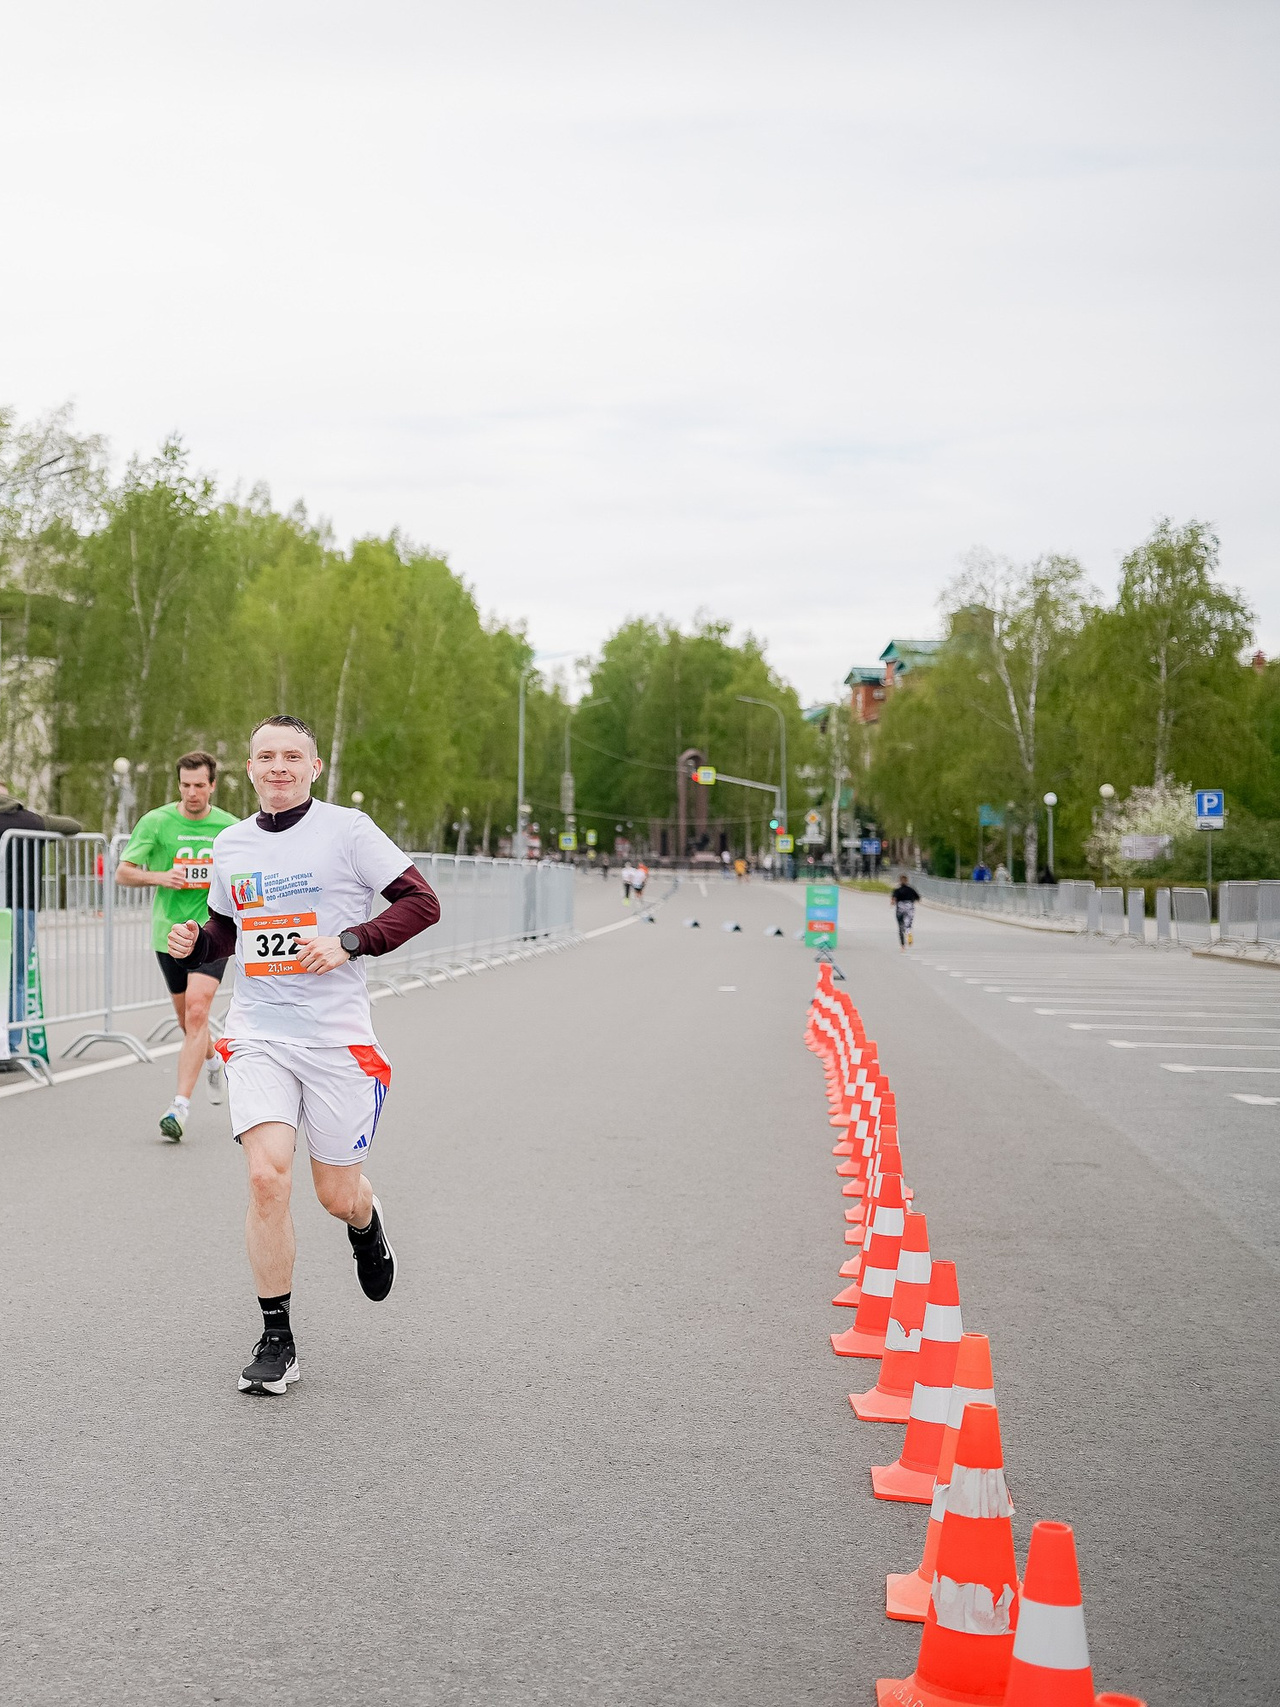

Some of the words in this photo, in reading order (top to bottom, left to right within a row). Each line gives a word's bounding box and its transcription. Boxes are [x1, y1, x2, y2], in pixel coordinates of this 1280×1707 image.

[1203, 793, 1219, 816] P
[185, 867, 208, 879] 188
[256, 932, 302, 957] 322
